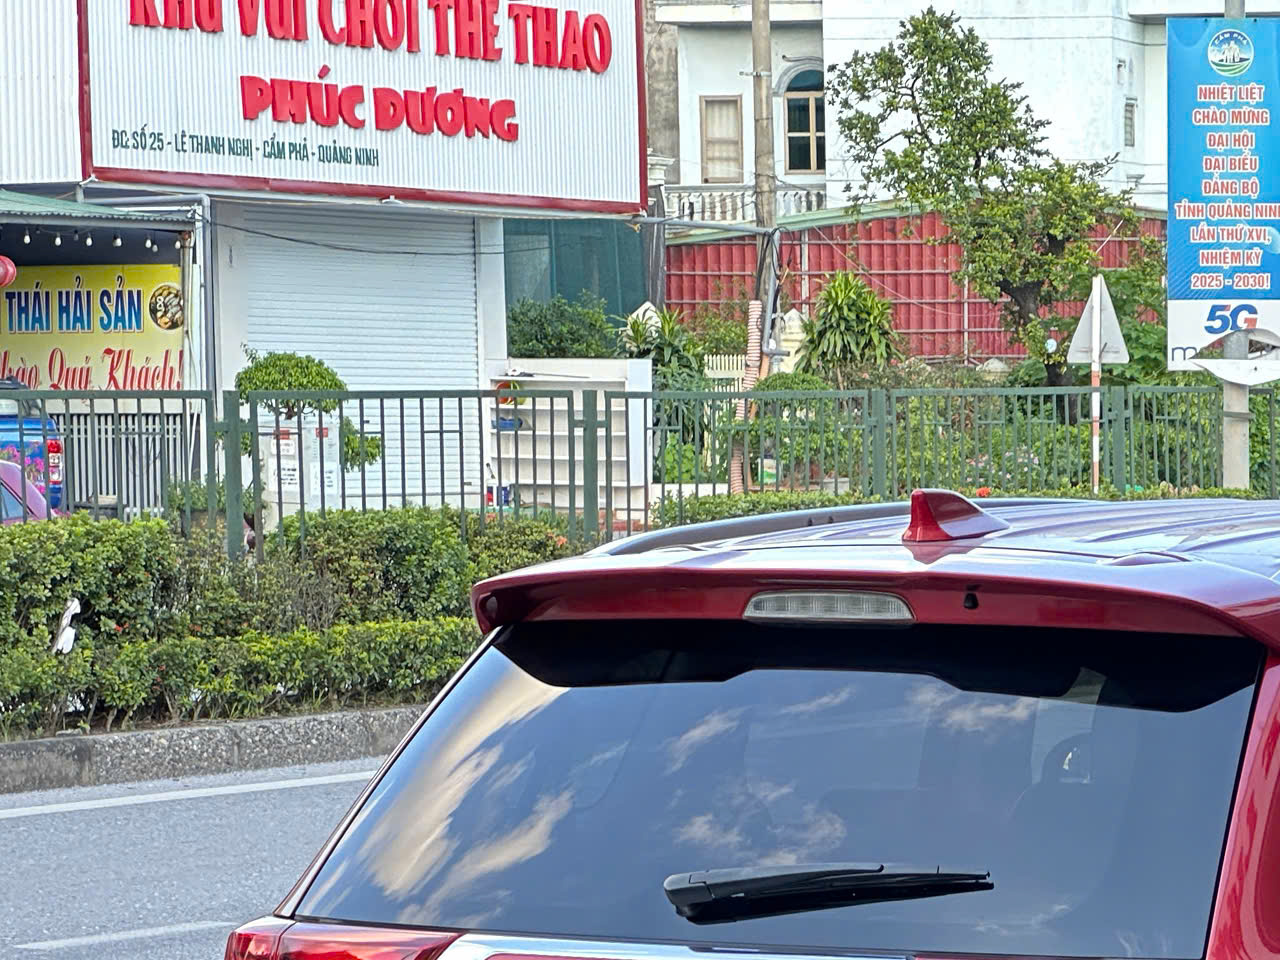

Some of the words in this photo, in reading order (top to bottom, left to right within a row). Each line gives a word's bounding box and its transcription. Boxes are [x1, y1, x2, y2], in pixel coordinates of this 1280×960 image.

[508, 3, 612, 75] THAO
[240, 64, 365, 130] PHÚC
[1198, 83, 1235, 103] NHIỆT
[1238, 83, 1264, 103] LIỆT
[1193, 107, 1227, 124] CHÀO
[1231, 107, 1269, 124] MỪNG
[132, 123, 147, 151] SỐ
[149, 132, 164, 151] 25
[174, 130, 187, 153] LÊ
[189, 134, 226, 155] THANH
[227, 137, 253, 161] NGHỊ
[318, 139, 352, 165] QUẢNG
[355, 147, 379, 167] NINH
[1208, 133, 1229, 151] ĐẠI
[1233, 131, 1254, 151] HỘI
[1204, 156, 1225, 174] ĐẠI
[1229, 151, 1258, 171] BIỂU
[1203, 176, 1238, 195] ĐẢNG
[1241, 177, 1258, 198] BỘ
[1176, 199, 1204, 218] TỈNH
[1208, 199, 1251, 219] QUẢNG
[1247, 227, 1271, 244] XVI,
[1200, 247, 1242, 268] NHIỆM
[1192, 274, 1223, 288] 2025
[1235, 274, 1270, 288] 2030!
[5, 281, 51, 332] THÁI
[57, 275, 92, 332] HẢI
[99, 275, 143, 332] SẢN
[1204, 304, 1258, 334] 5G
